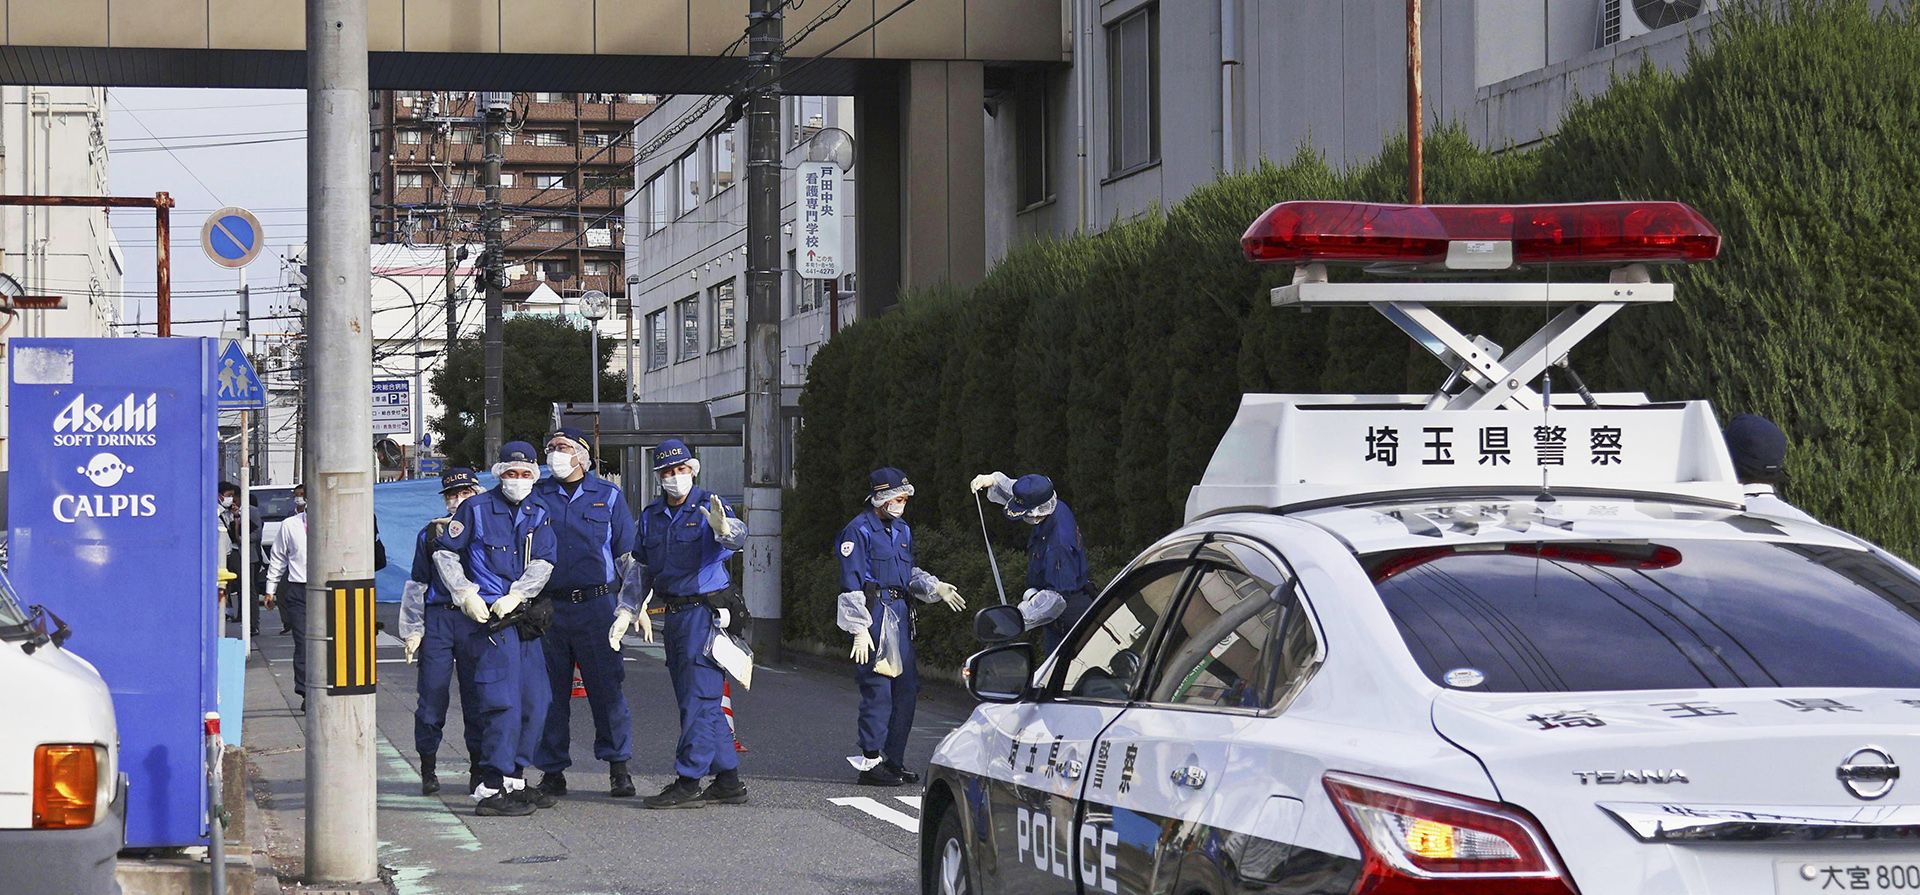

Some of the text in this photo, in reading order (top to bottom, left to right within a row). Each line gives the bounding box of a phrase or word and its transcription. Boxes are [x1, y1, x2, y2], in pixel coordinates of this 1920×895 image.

[821, 166, 834, 216] 戸田中央
[805, 172, 819, 248] 看護専門学校
[53, 392, 157, 433] Asahi
[390, 394, 398, 404] P
[53, 434, 157, 447] SOFT DRINKS
[1365, 425, 1622, 467] 埼玉県警察
[53, 494, 157, 523] CALPIS
[1572, 768, 1690, 785] TEANA
[1017, 807, 1119, 894] POLICE
[1820, 865, 1920, 890] 大宮 800
